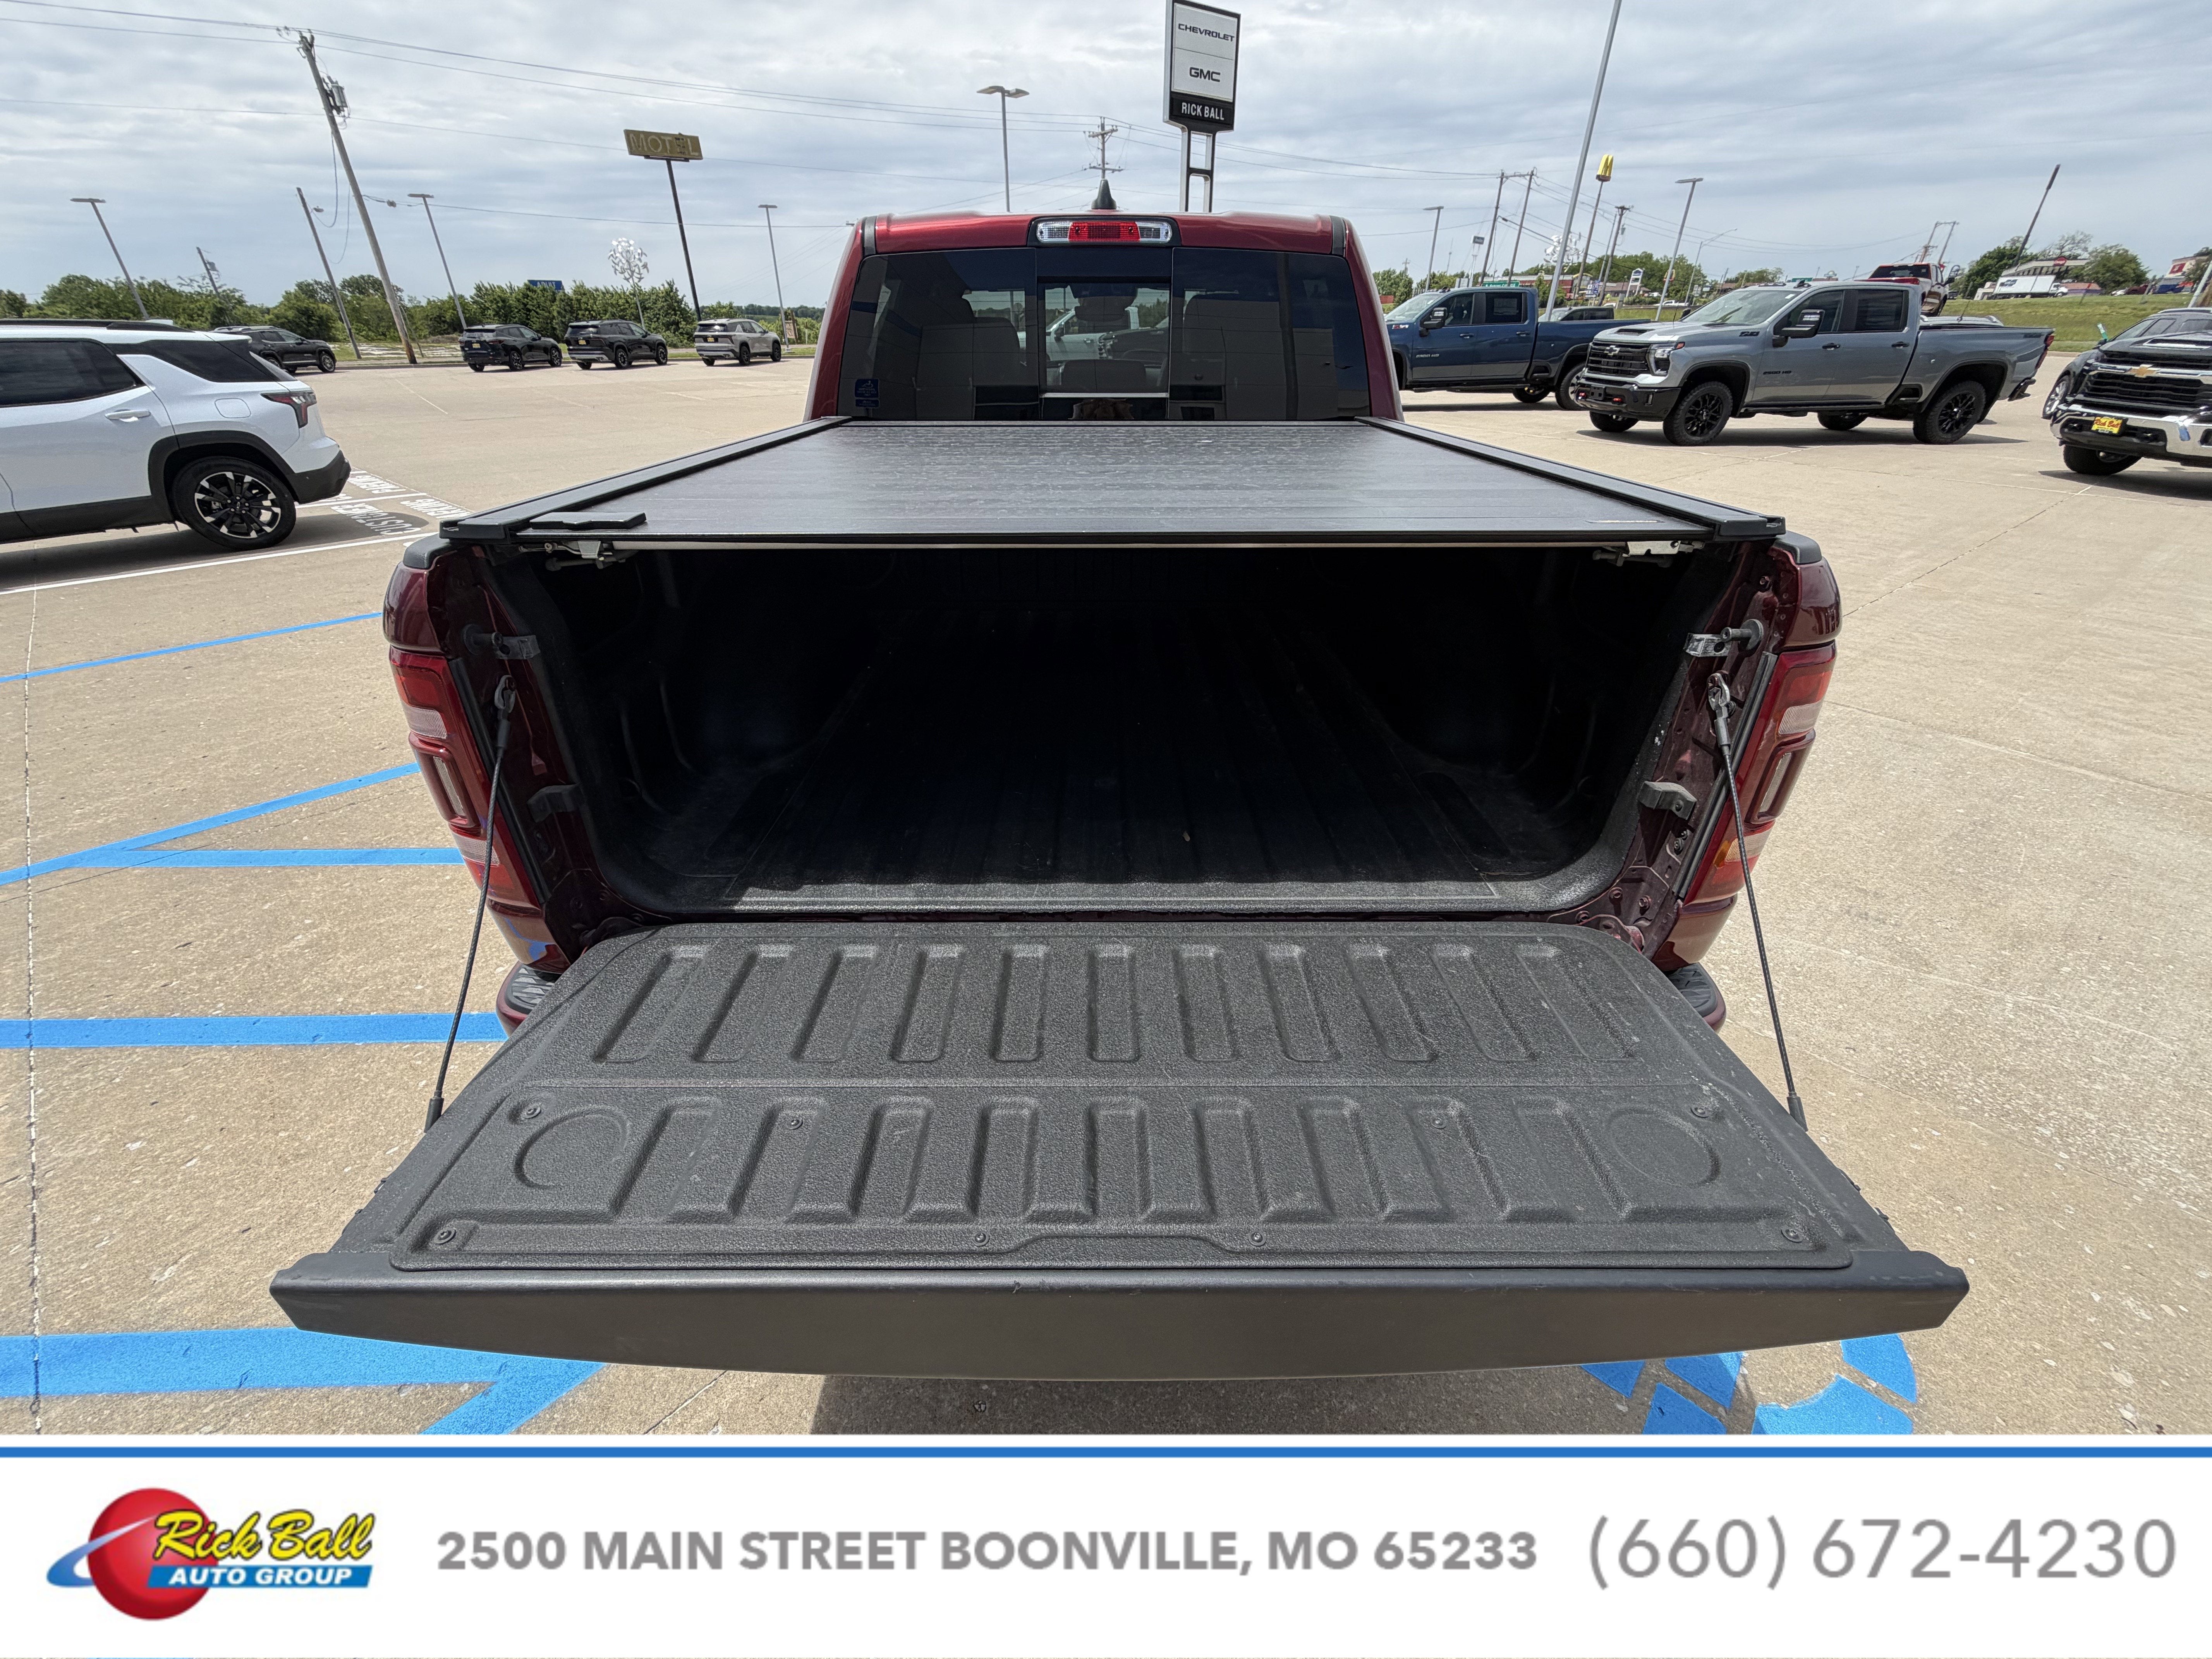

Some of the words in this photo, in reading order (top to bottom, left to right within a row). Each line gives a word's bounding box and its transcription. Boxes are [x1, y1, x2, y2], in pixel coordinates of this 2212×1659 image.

[1178, 23, 1235, 41] CHEVROLET
[1189, 67, 1221, 82] GMC
[1182, 102, 1202, 117] RICK
[1204, 106, 1224, 120] BALL
[630, 134, 699, 156] MOTEL
[331, 503, 422, 535] CUSTOMER
